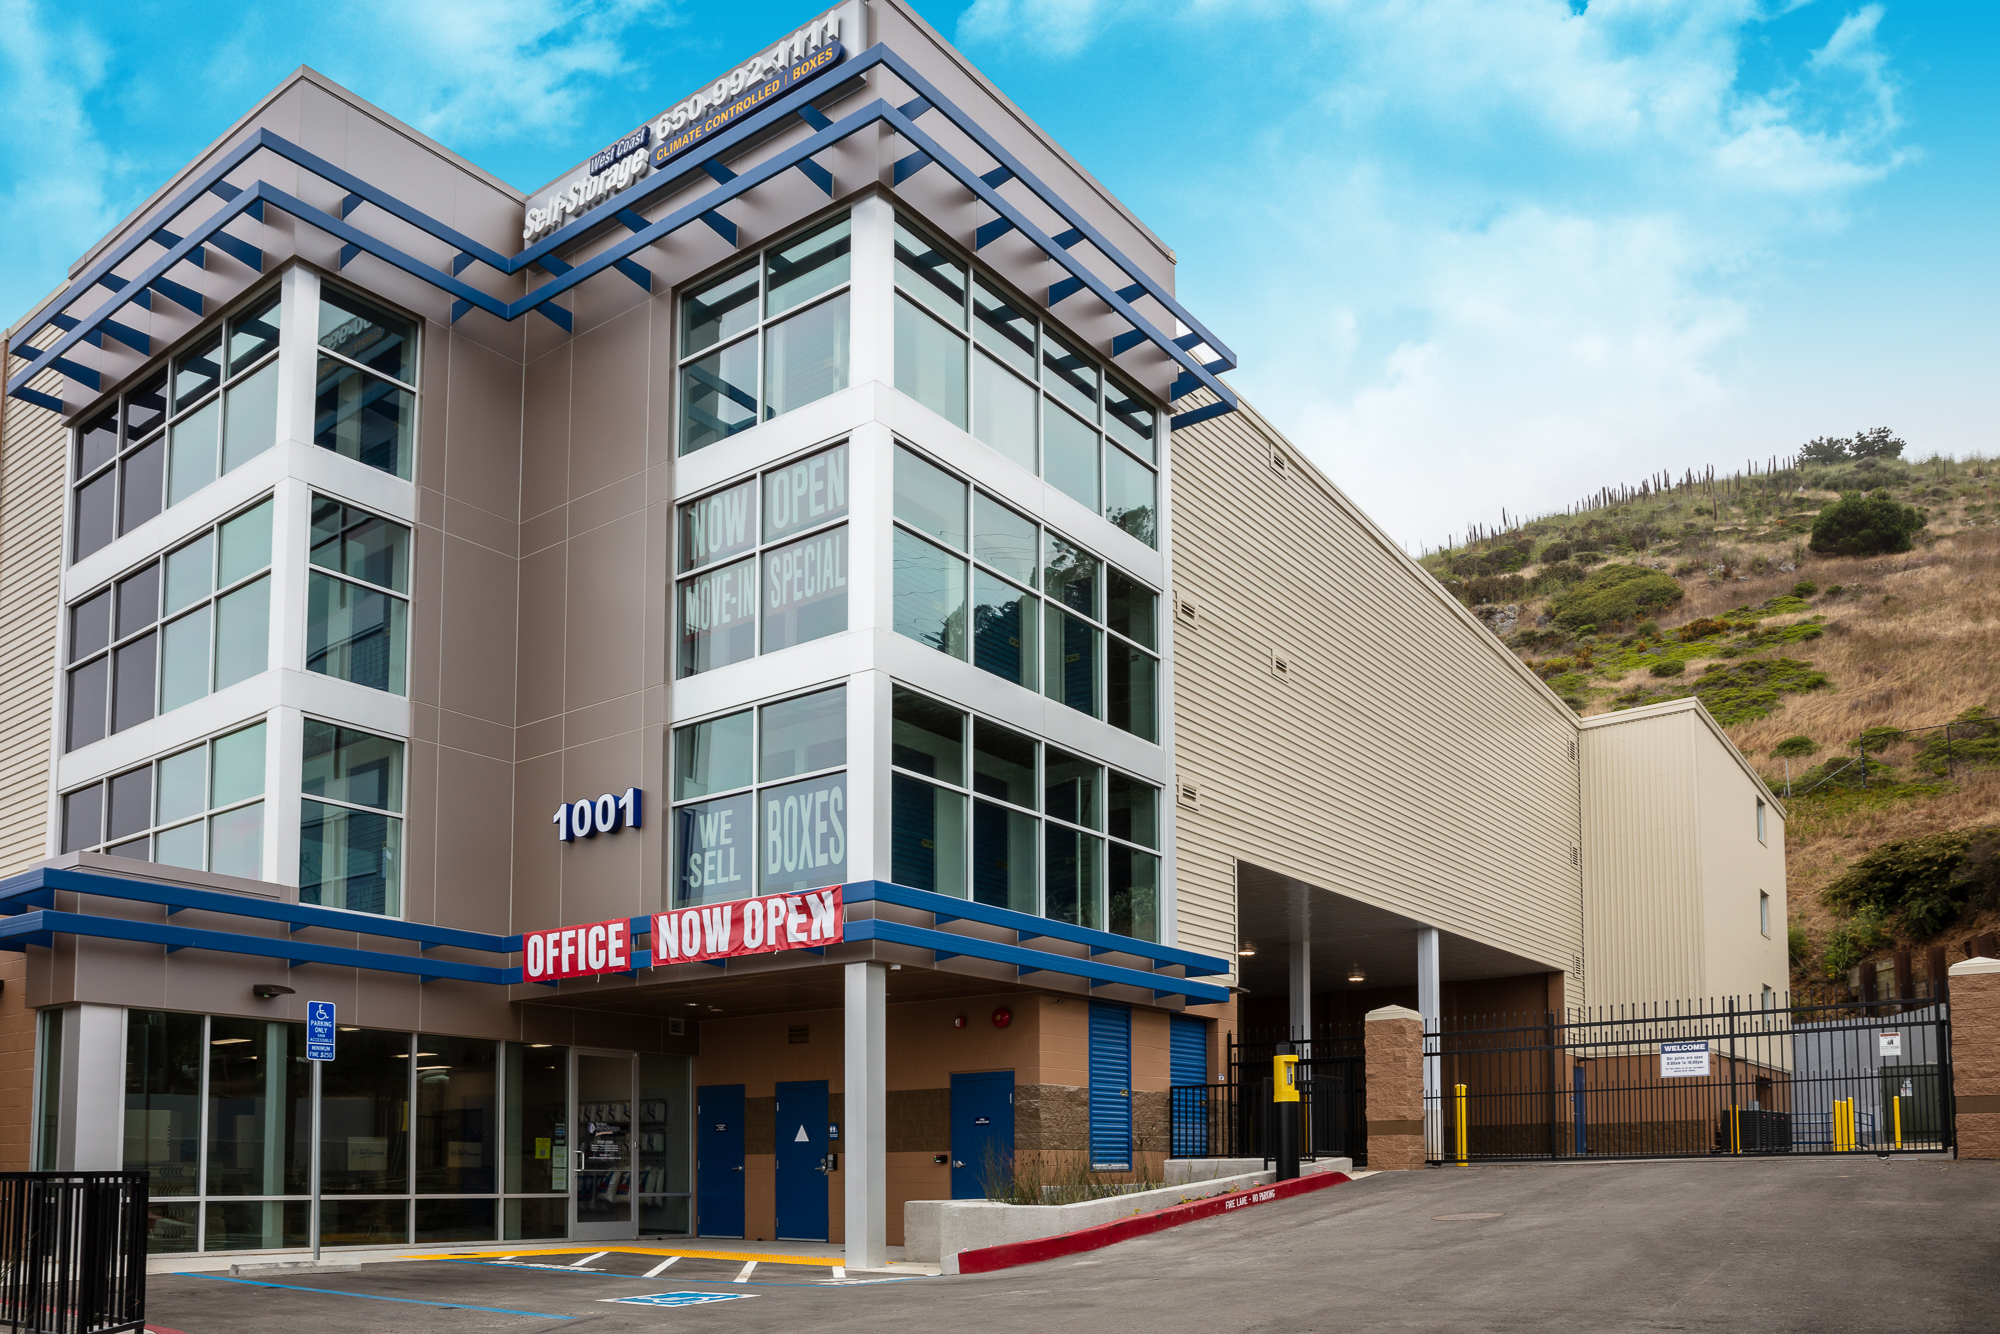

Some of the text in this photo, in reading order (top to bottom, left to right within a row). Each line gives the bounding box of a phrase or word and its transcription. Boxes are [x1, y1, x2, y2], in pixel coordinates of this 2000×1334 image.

[656, 9, 839, 141] 650-992-1111
[656, 47, 833, 161] CLIMATE CONTROLLED BOXES
[590, 128, 646, 172] West Coast
[523, 147, 648, 240] Self-Storage
[690, 448, 845, 561] NOW OPEN
[685, 534, 846, 636] MOVE-IN SPECIAL
[552, 787, 640, 842] 1001
[699, 809, 733, 849] WE
[767, 785, 845, 876] BOXES
[689, 846, 741, 888] SELL
[527, 922, 626, 977] OFFICE
[658, 890, 836, 960] NOW OPEN
[1226, 1199, 1235, 1210] FIRE
[1237, 1196, 1247, 1206] LANE
[1252, 1194, 1258, 1202] NO
[1259, 1189, 1275, 1201] PARKING
